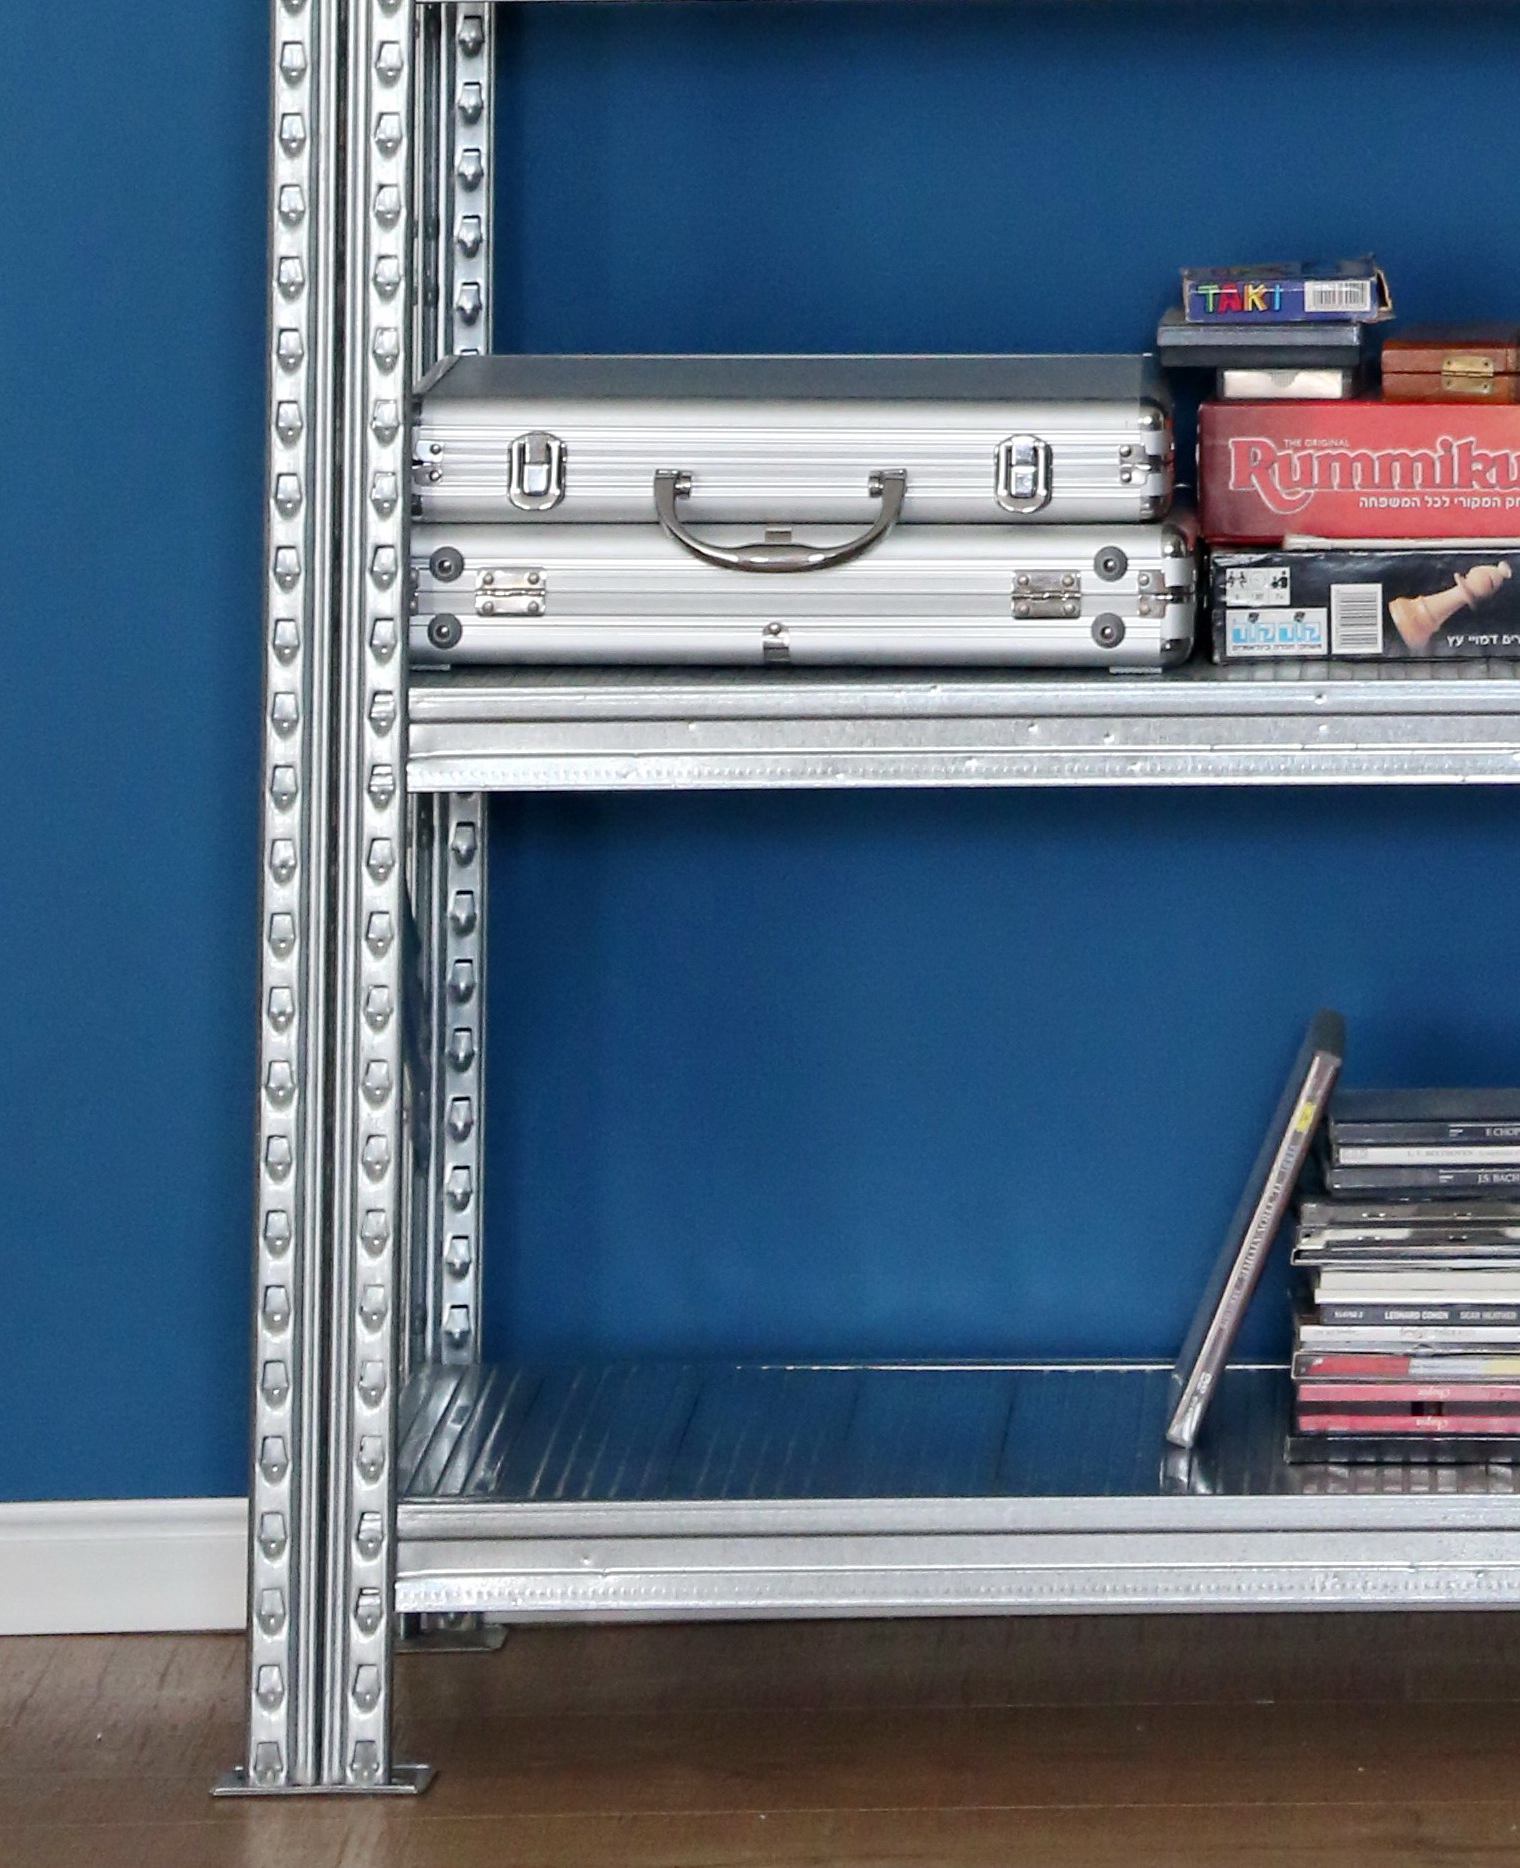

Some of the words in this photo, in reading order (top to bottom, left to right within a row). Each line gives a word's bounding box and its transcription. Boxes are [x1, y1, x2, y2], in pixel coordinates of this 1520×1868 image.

[1198, 282, 1282, 313] TAKI
[1305, 438, 1349, 446] ORIGINAL
[1359, 496, 1420, 507] המשפחה
[1426, 495, 1450, 507] לכל
[1455, 495, 1500, 509] המקורי
